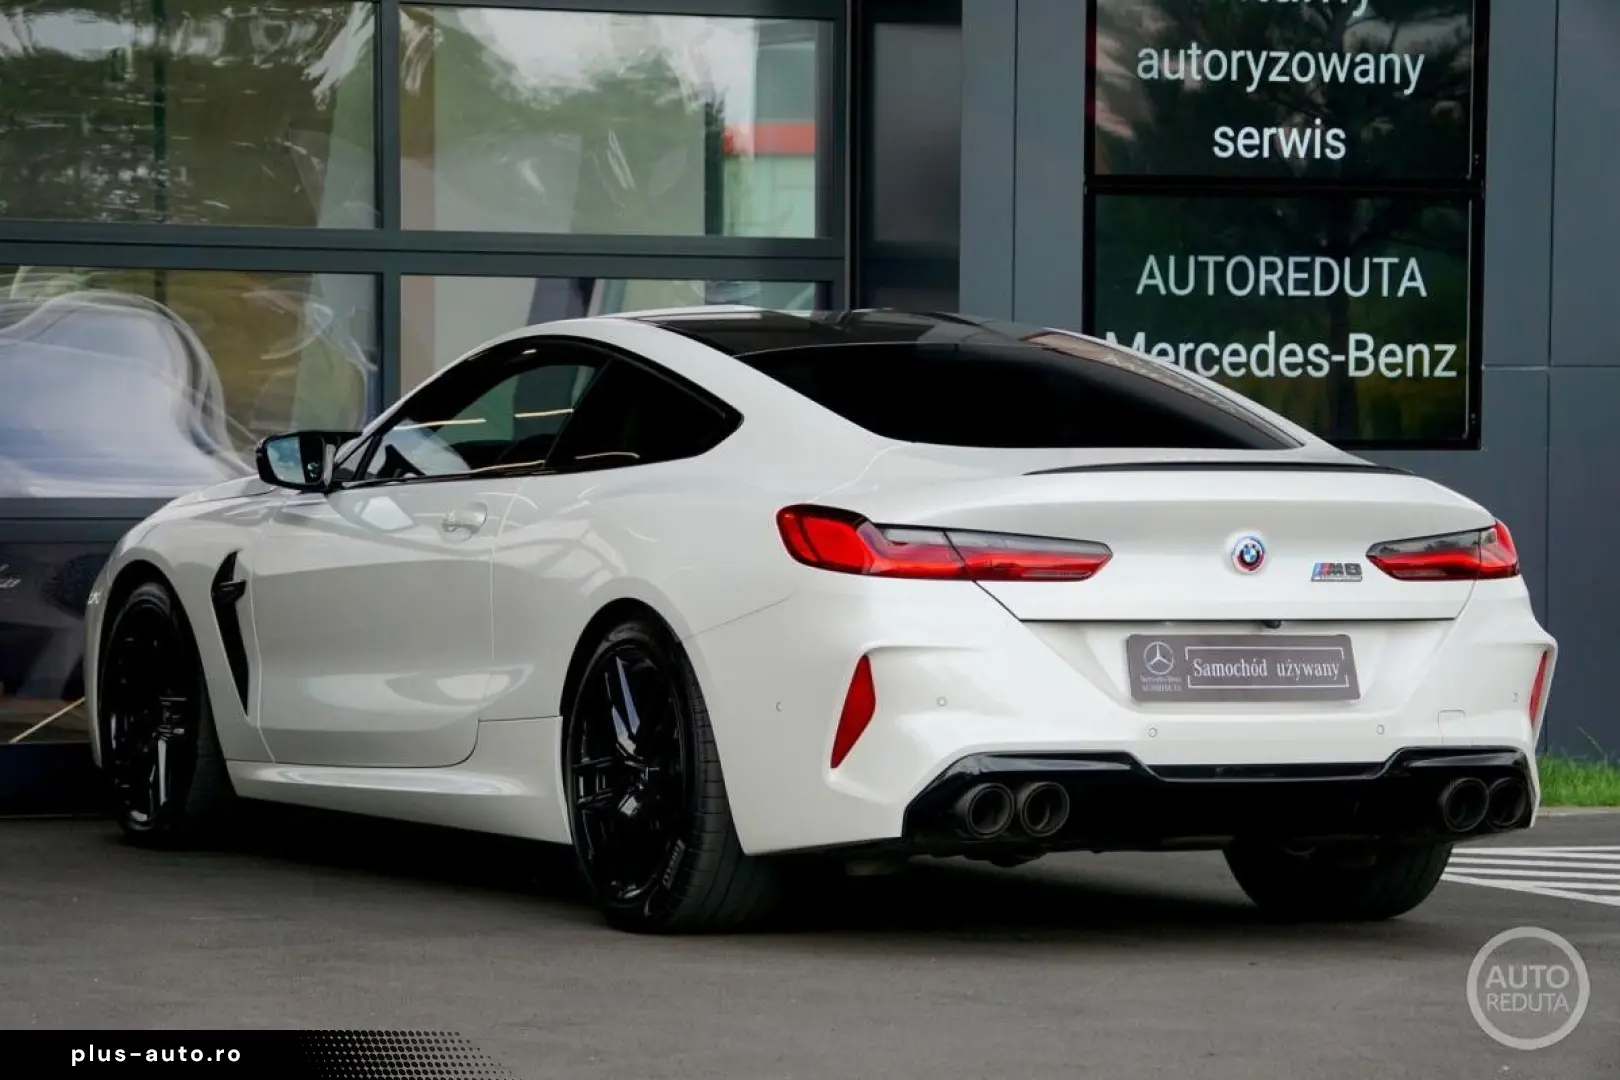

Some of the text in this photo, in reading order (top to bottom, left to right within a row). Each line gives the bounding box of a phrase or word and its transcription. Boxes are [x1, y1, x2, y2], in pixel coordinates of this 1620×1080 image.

[1136, 41, 1425, 96] autoryzowany
[1212, 118, 1347, 161] serwis
[1135, 254, 1428, 299] AUTOREDUTA
[1193, 658, 1340, 682] Samochód używany
